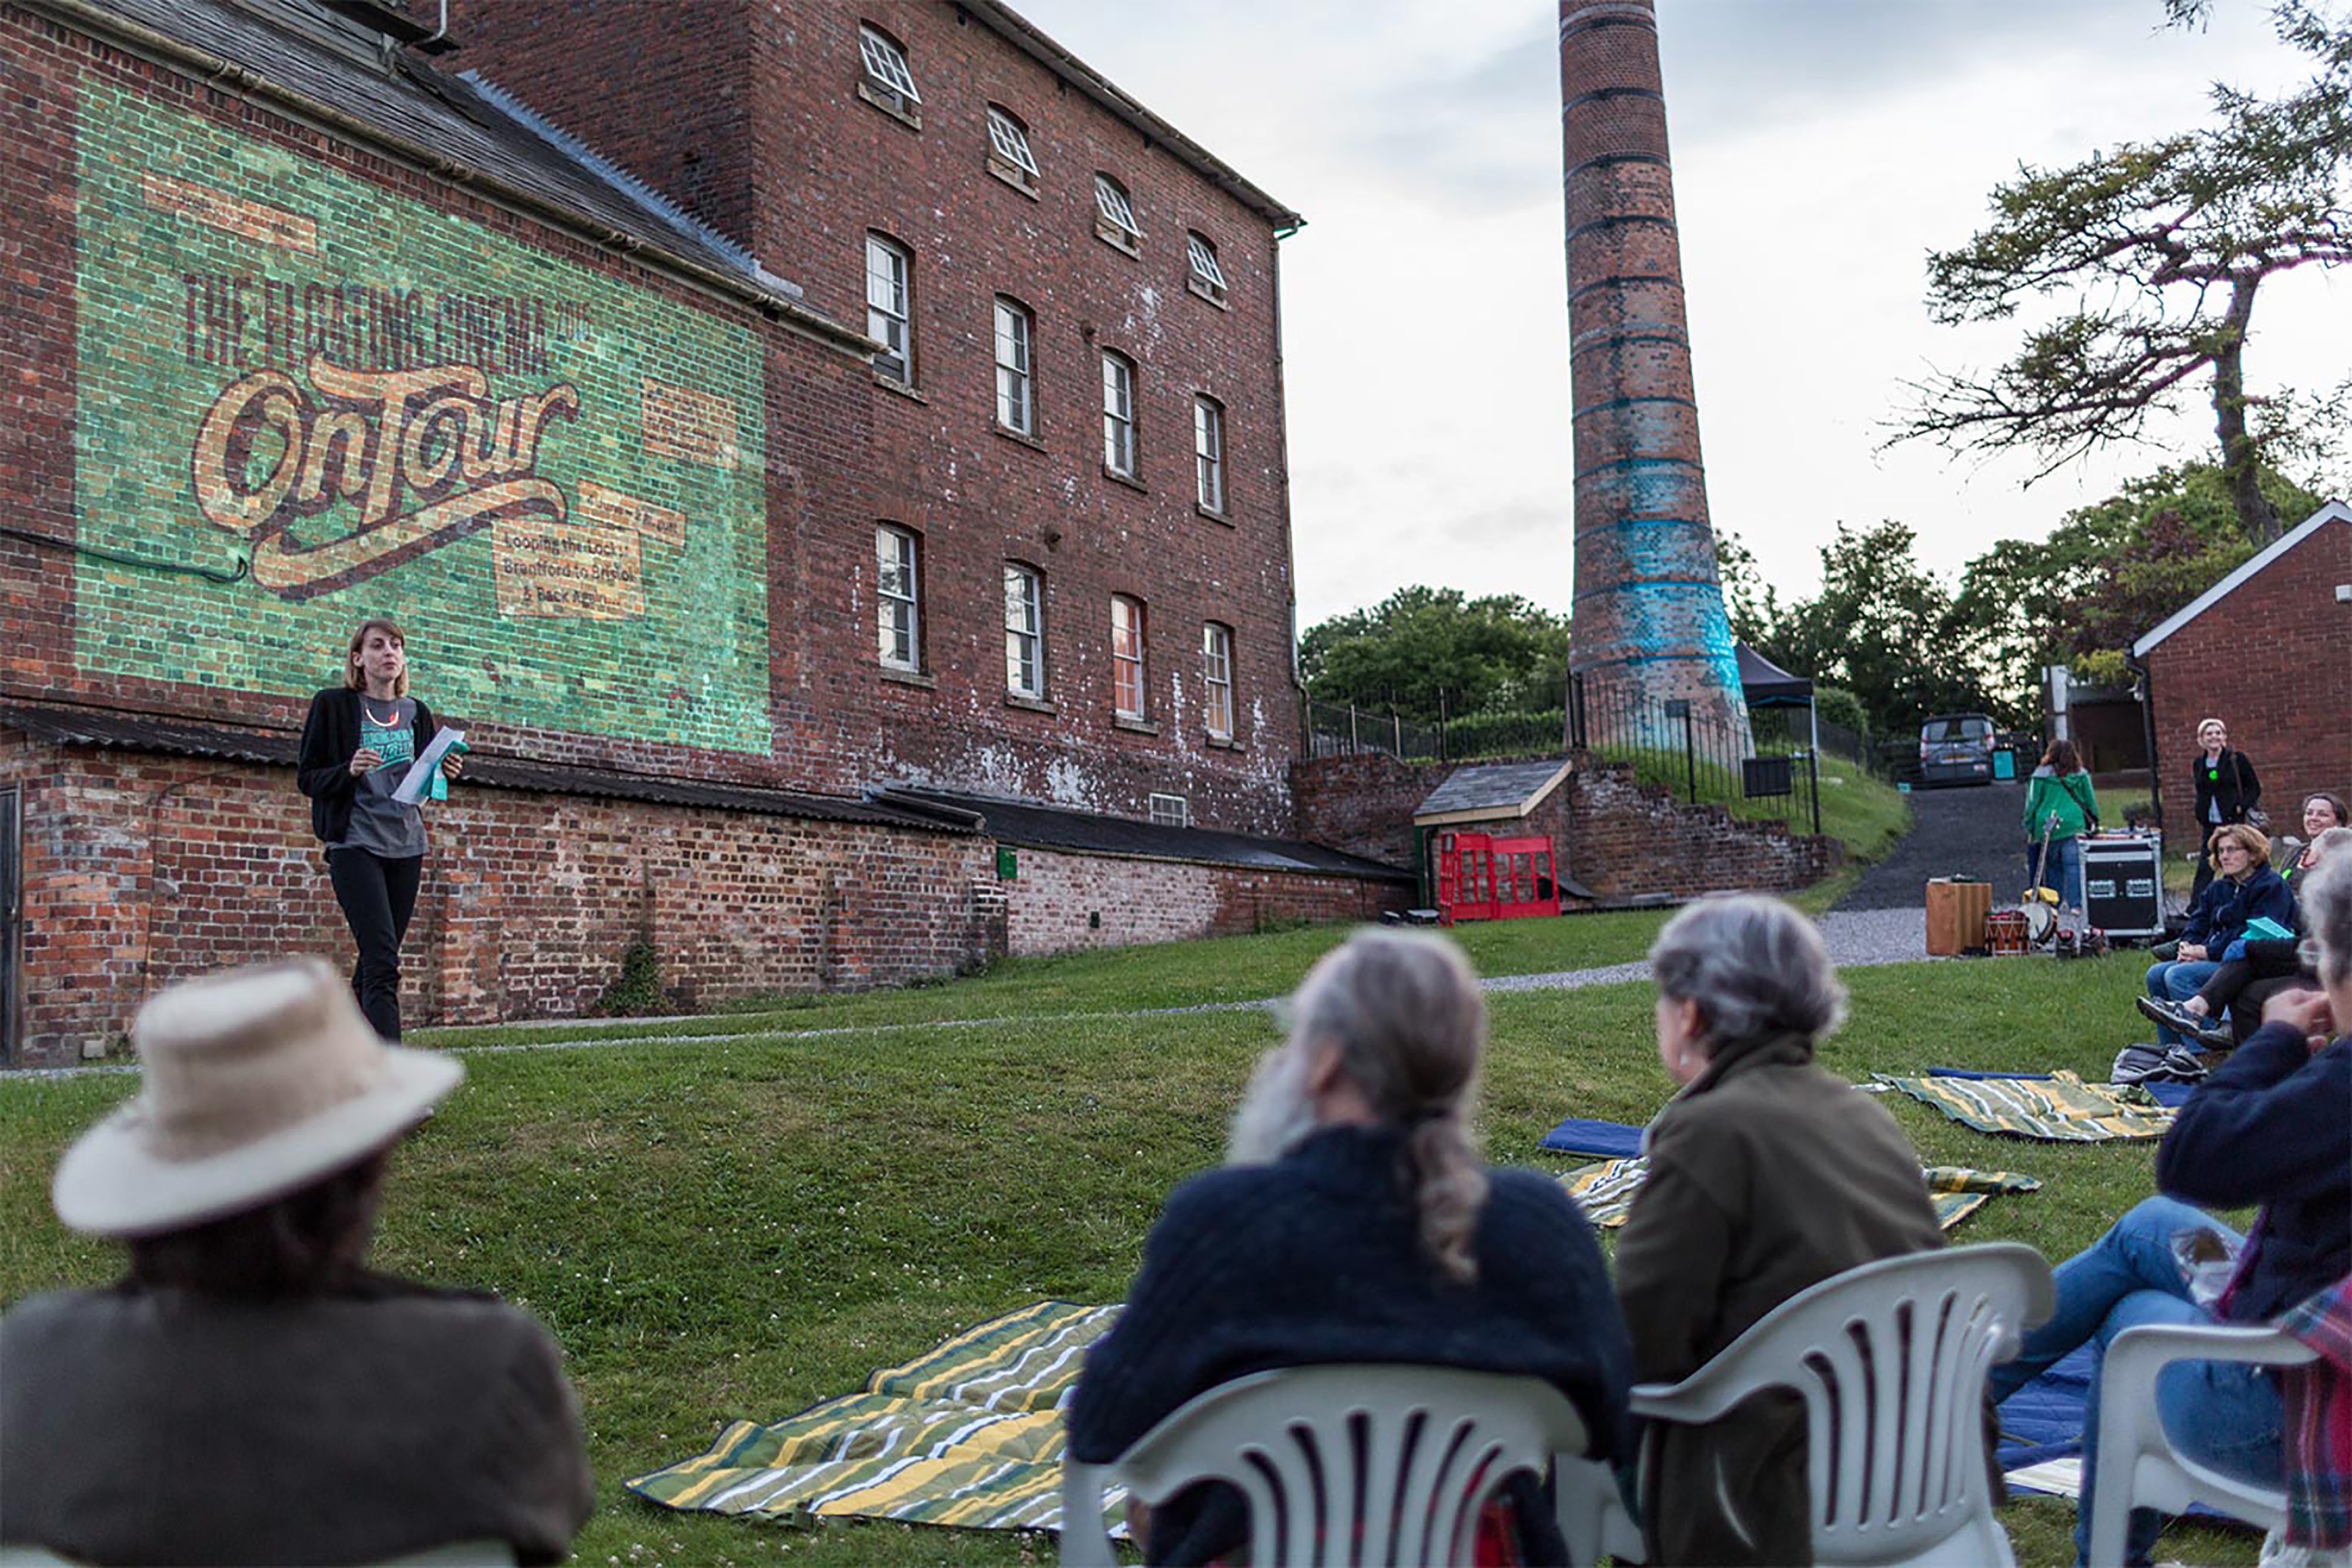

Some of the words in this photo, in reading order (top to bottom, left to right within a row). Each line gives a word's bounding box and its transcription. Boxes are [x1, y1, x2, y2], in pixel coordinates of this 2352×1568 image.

[183, 273, 253, 366] THE
[264, 276, 425, 375] FLOATING
[435, 291, 549, 376] CINEMA
[504, 531, 560, 556] Looping
[562, 537, 584, 553] the
[503, 557, 571, 577] Brentford
[574, 564, 588, 580] to
[590, 563, 635, 583] Bristol
[535, 587, 570, 603] Back
